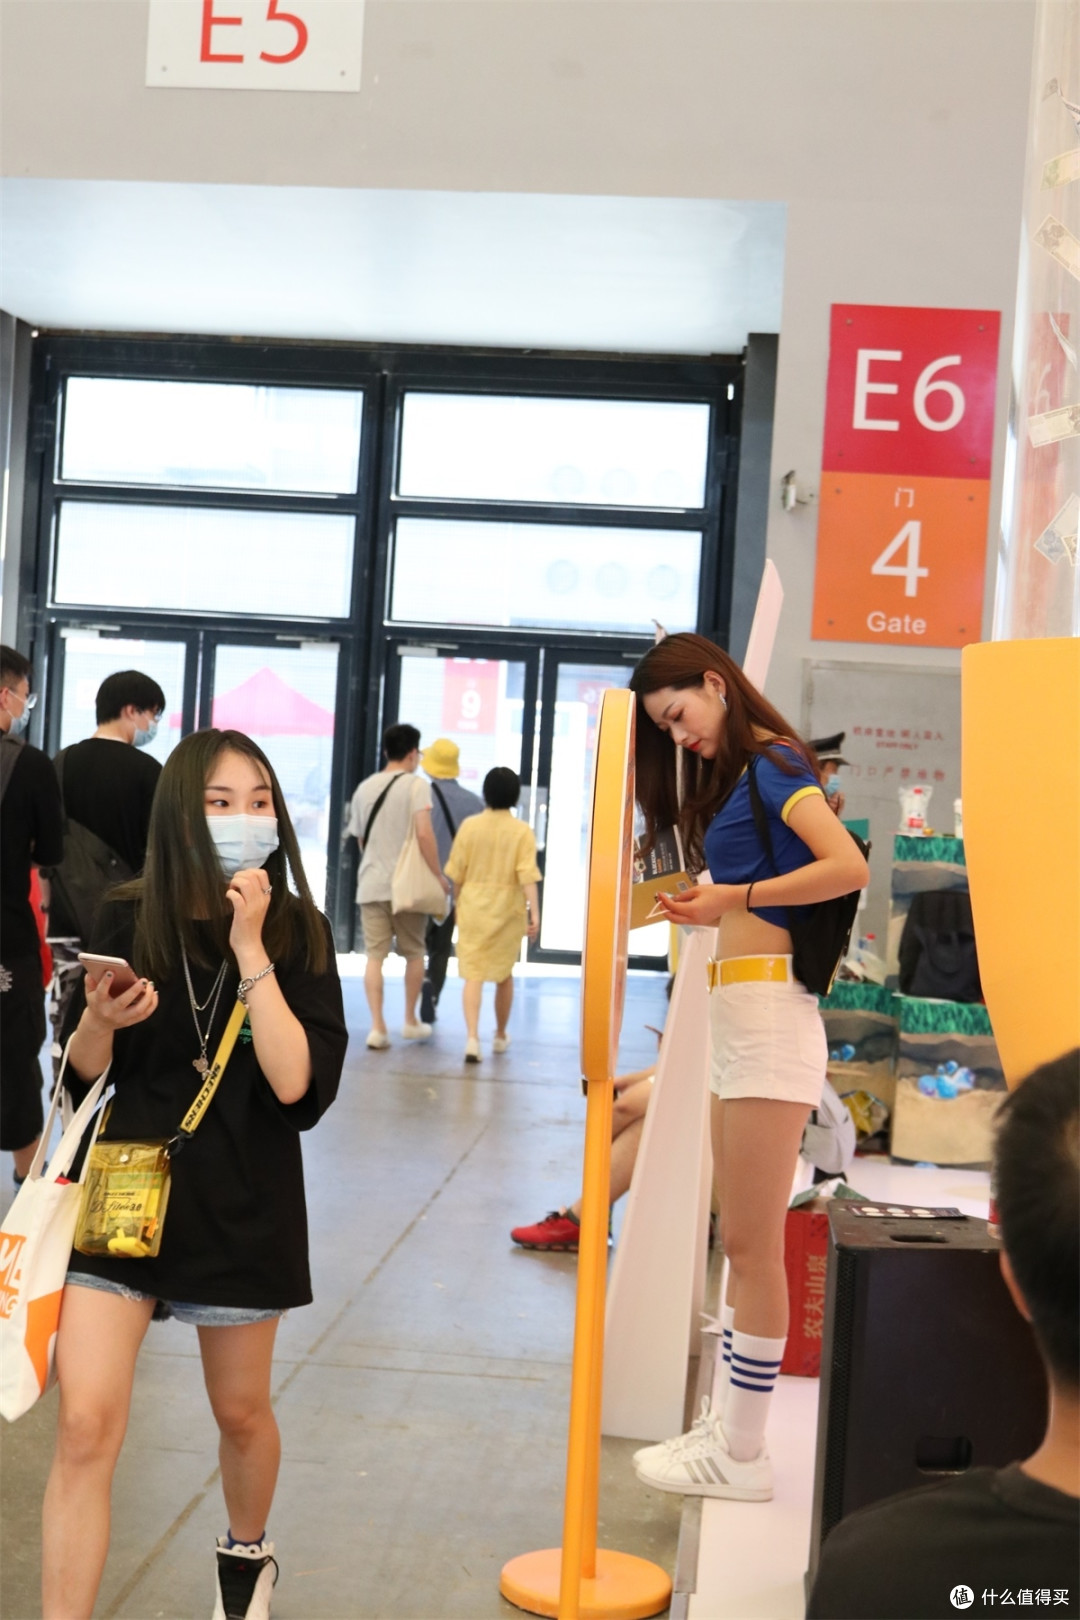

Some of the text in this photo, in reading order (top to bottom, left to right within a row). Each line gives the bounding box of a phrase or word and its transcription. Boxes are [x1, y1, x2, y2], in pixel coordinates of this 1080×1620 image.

[200, 0, 309, 64] E5
[853, 349, 965, 432] E6
[894, 487, 915, 508] 门
[871, 520, 929, 597] 4
[866, 611, 927, 635] Gate
[184, 1062, 221, 1129] SKECHERS
